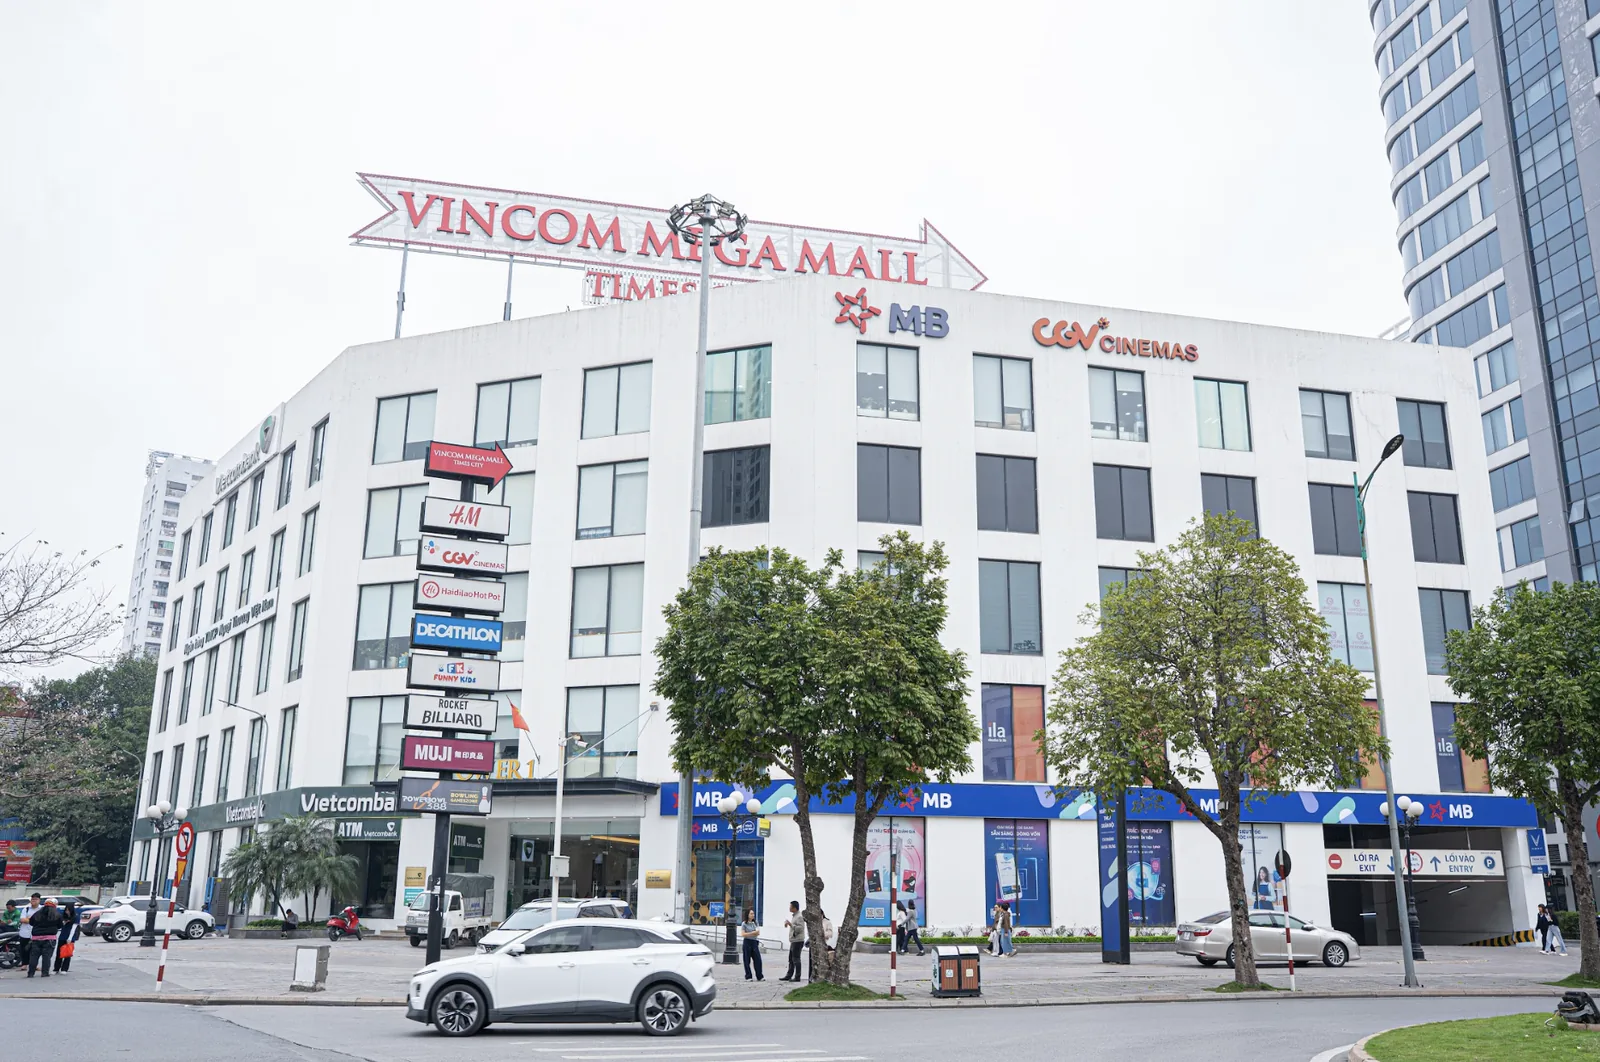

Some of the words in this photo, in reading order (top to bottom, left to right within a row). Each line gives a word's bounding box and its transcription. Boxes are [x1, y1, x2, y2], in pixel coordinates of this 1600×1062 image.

[397, 190, 626, 253] VINCOM
[794, 241, 929, 286] MALL
[889, 303, 949, 338] MB
[1032, 317, 1100, 350] CGV
[1100, 334, 1199, 362] CINEMAS
[433, 449, 464, 459] VINCOM
[465, 453, 485, 461] MEGA
[486, 456, 504, 464] MALL
[449, 505, 481, 527] H&M
[442, 551, 474, 565] CGV
[473, 560, 505, 569] CINEMAS
[474, 591, 487, 599] Hot
[488, 593, 500, 601] Pot
[416, 622, 500, 643] DECATHLON
[433, 674, 459, 682] FUNNY
[438, 699, 468, 710] ROCKET
[422, 710, 482, 728] BILLIARD
[988, 721, 1006, 738] ila
[414, 744, 452, 762] MUJI
[454, 750, 484, 760] 無印良品
[695, 791, 722, 807] MB
[923, 793, 952, 808] MB
[1449, 804, 1473, 819] MB
[338, 822, 363, 837] ATM
[702, 823, 718, 833] MB
[453, 835, 467, 847] ATM
[1369, 854, 1380, 862] RA
[1458, 853, 1475, 863] VÀO
[1359, 864, 1376, 872] EXIT
[1449, 865, 1474, 873] ENTRY
